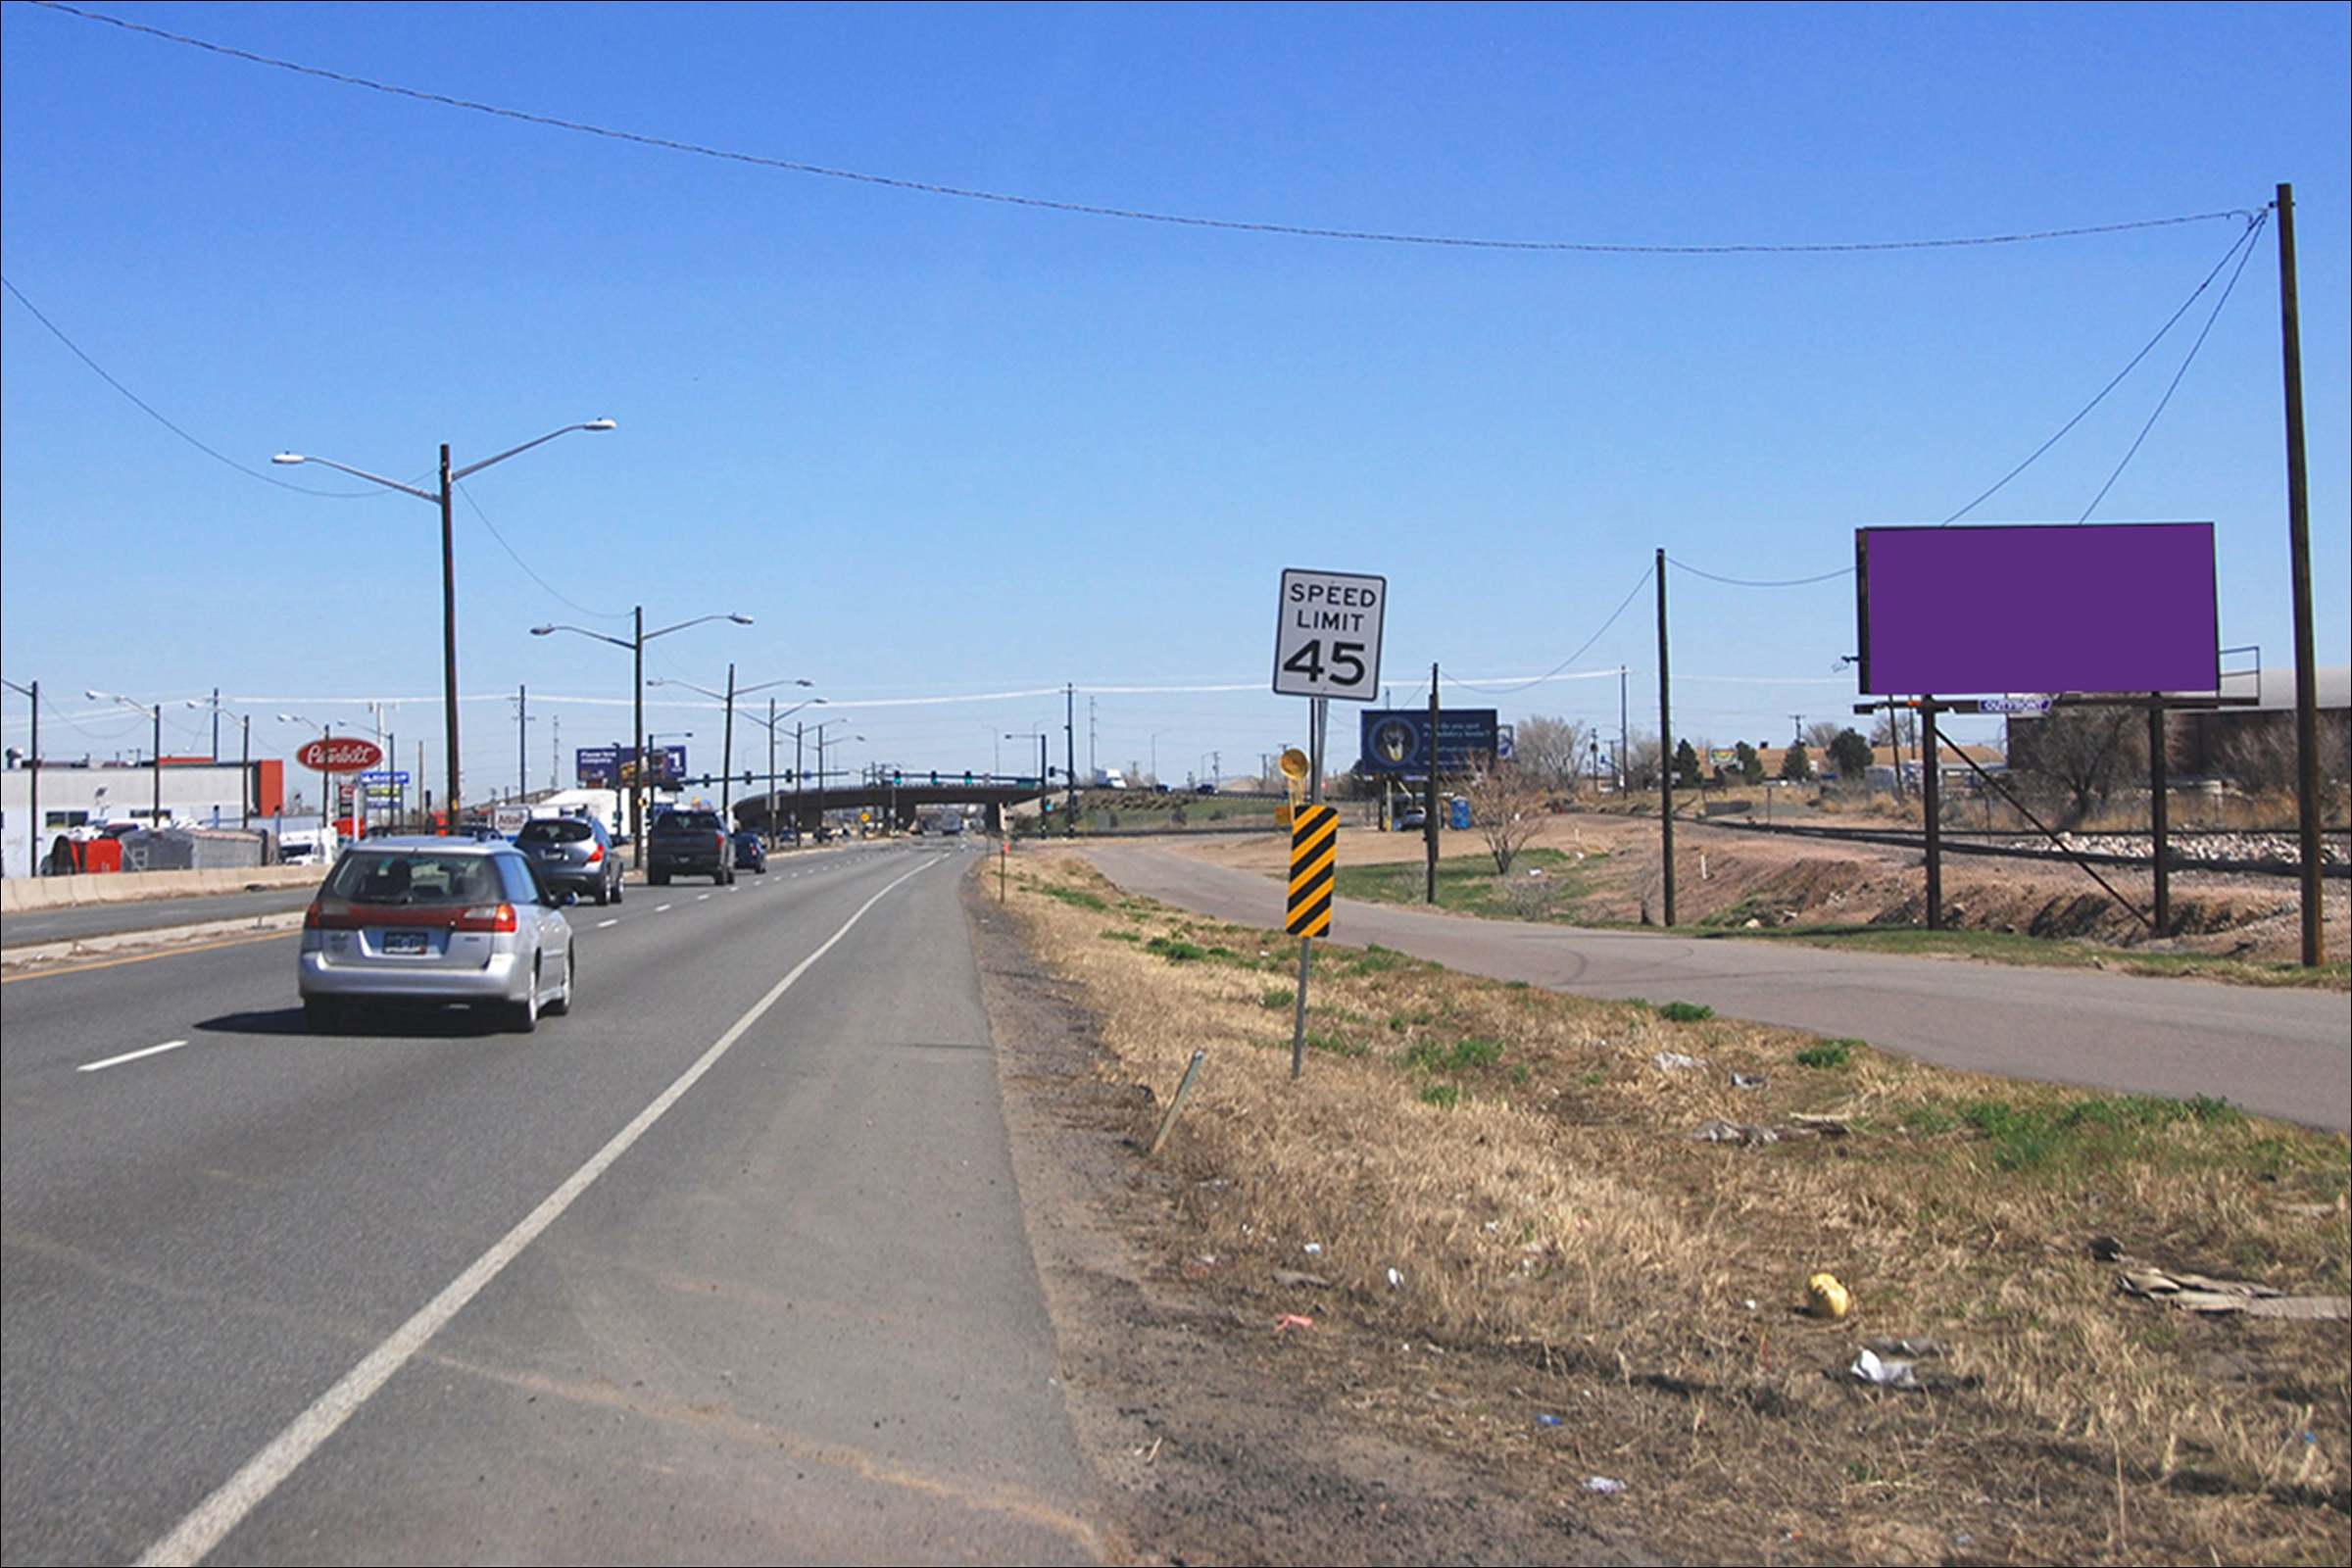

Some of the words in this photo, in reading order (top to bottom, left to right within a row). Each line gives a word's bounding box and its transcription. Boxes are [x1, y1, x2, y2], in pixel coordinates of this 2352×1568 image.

[1290, 583, 1377, 608] SPEED
[1297, 609, 1364, 632] LIMIT
[1283, 639, 1365, 687] 45
[307, 745, 374, 765] Peerbilt
